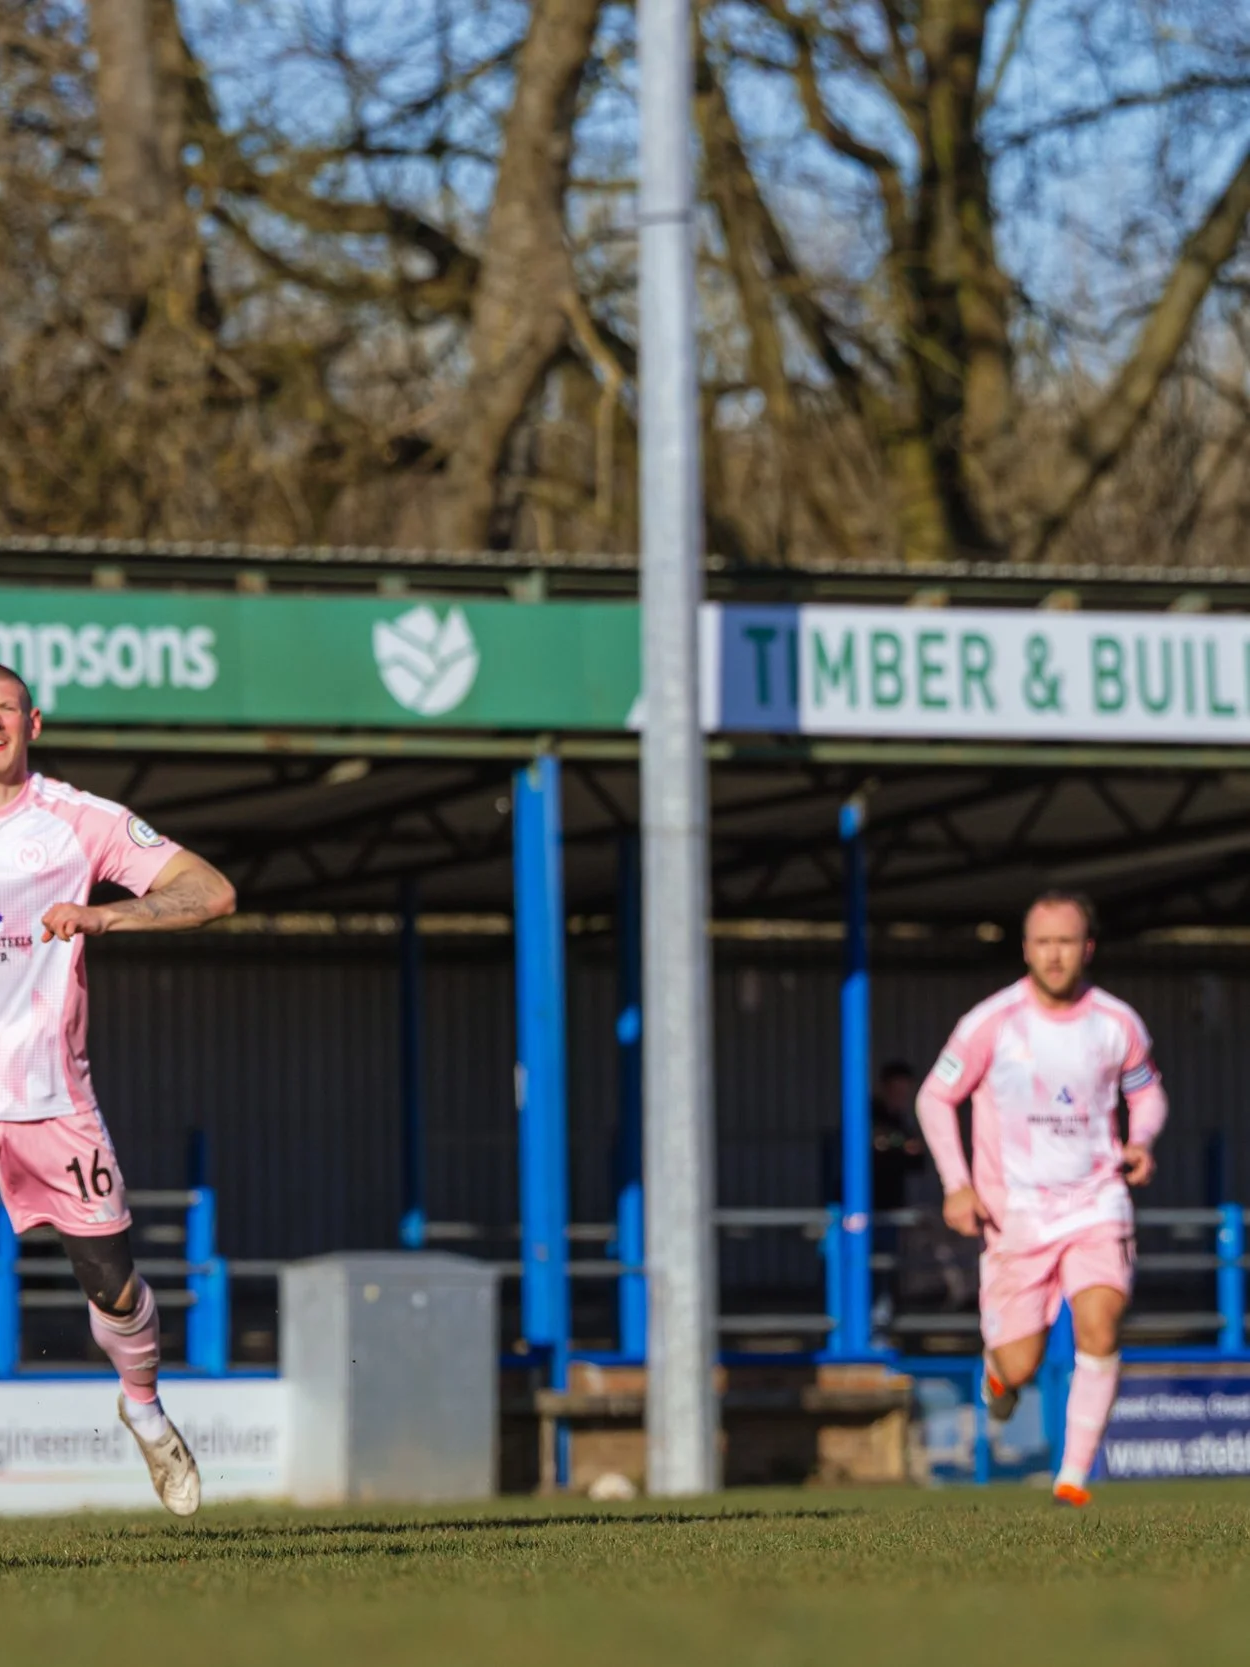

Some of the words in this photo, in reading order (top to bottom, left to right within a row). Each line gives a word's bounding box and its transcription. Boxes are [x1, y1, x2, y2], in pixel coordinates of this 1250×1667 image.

[741, 625, 998, 713] TIMBER
[1022, 635, 1063, 714] &
[1093, 635, 1250, 717] BUIL
[66, 1149, 113, 1204] 16
